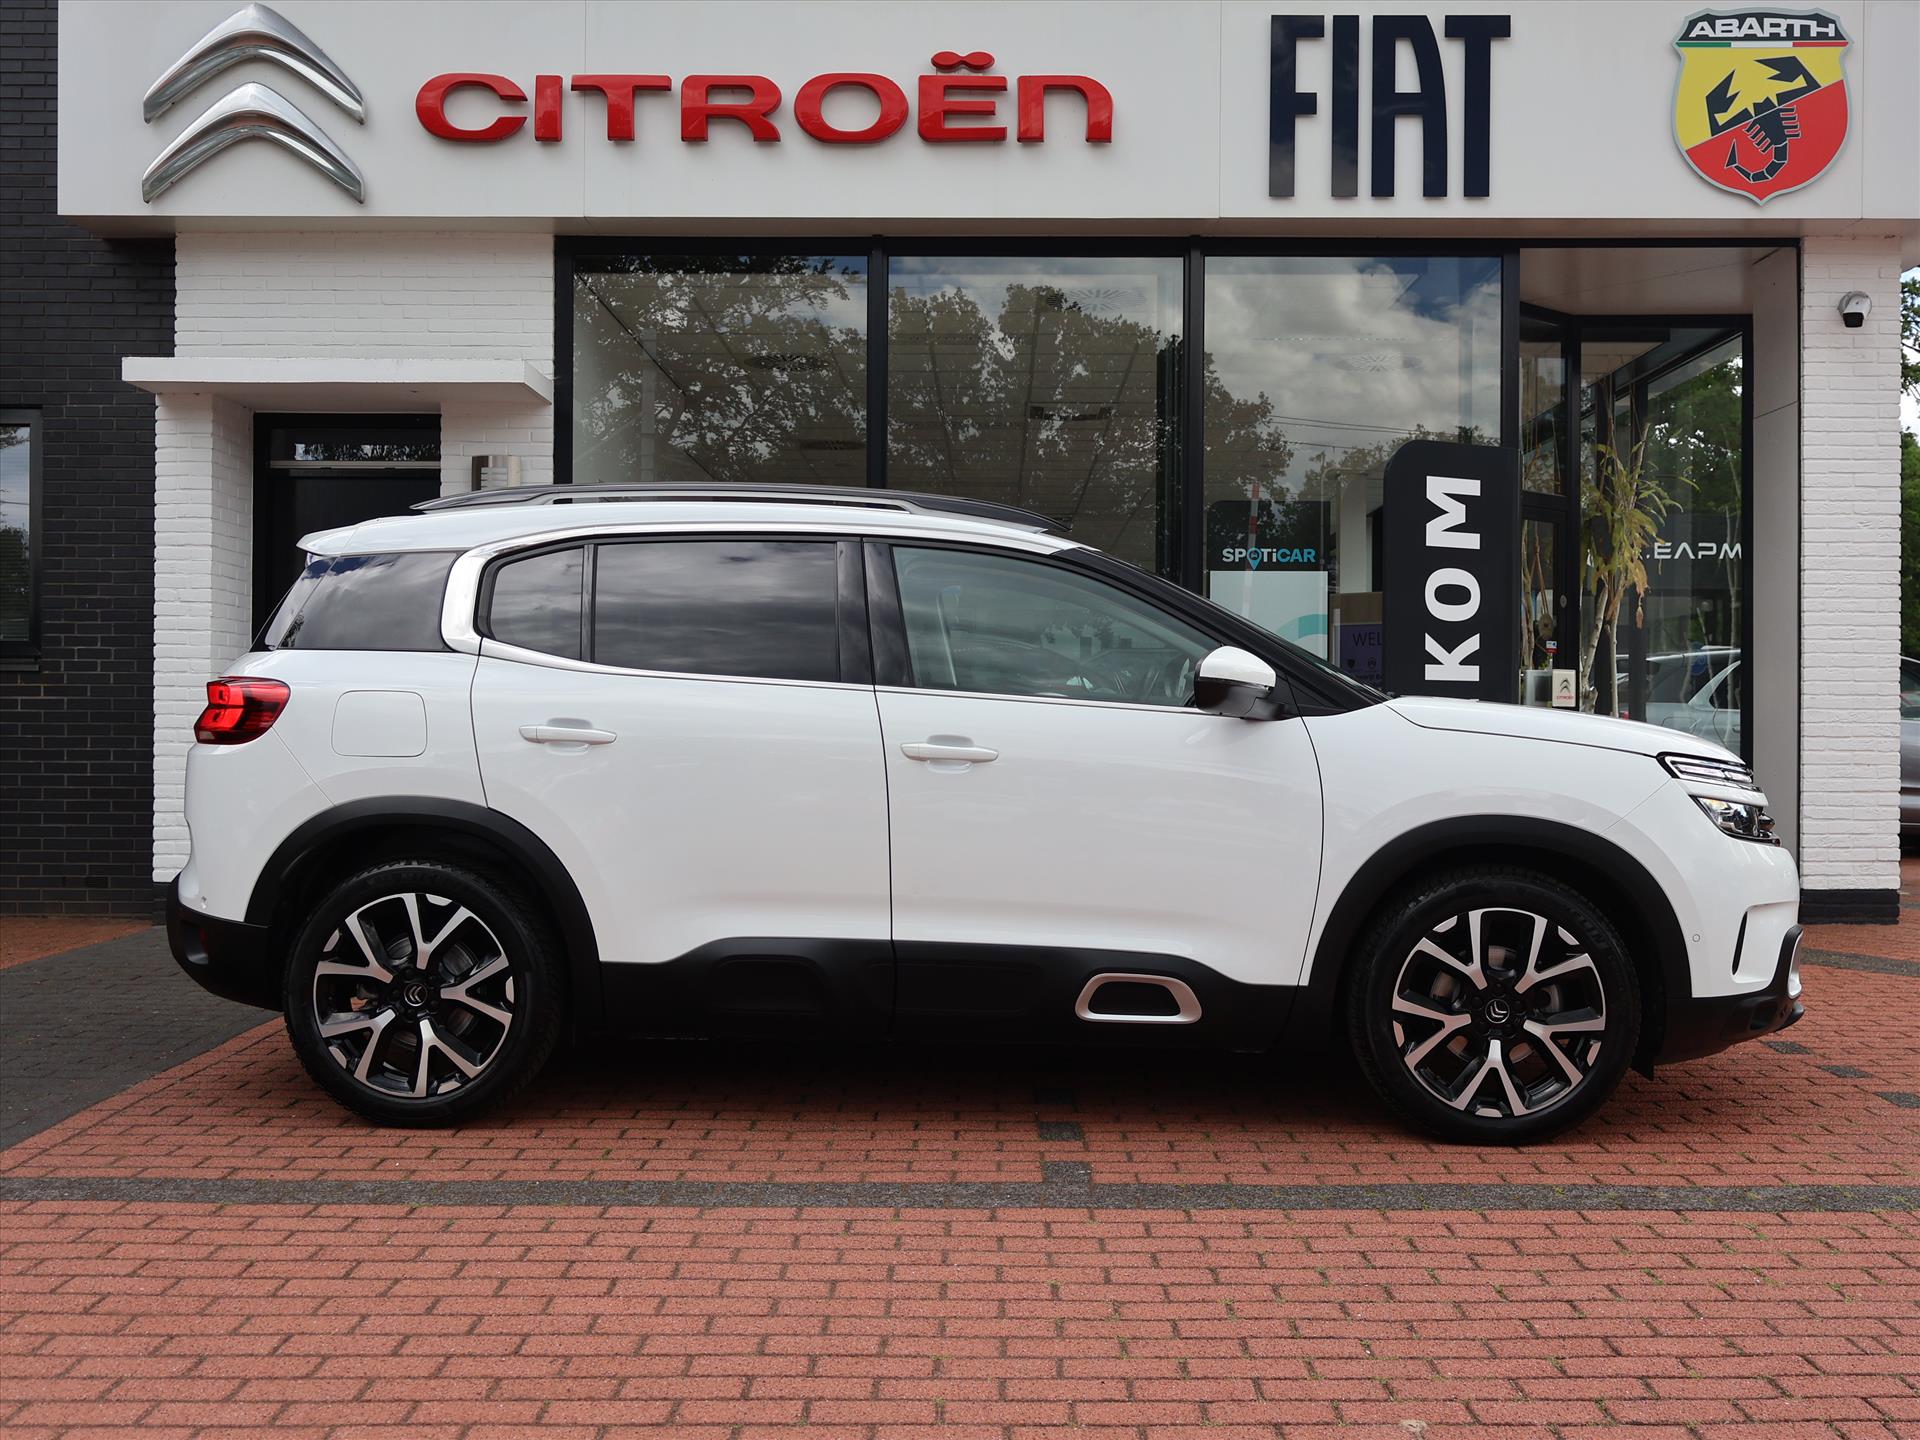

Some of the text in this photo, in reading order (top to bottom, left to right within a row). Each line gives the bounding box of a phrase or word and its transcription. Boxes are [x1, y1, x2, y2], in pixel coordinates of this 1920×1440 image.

[415, 51, 1114, 144] CITROËN
[1688, 18, 1837, 39] ABARTH
[1268, 14, 1512, 198] FIAT
[1424, 475, 1481, 682] KOM
